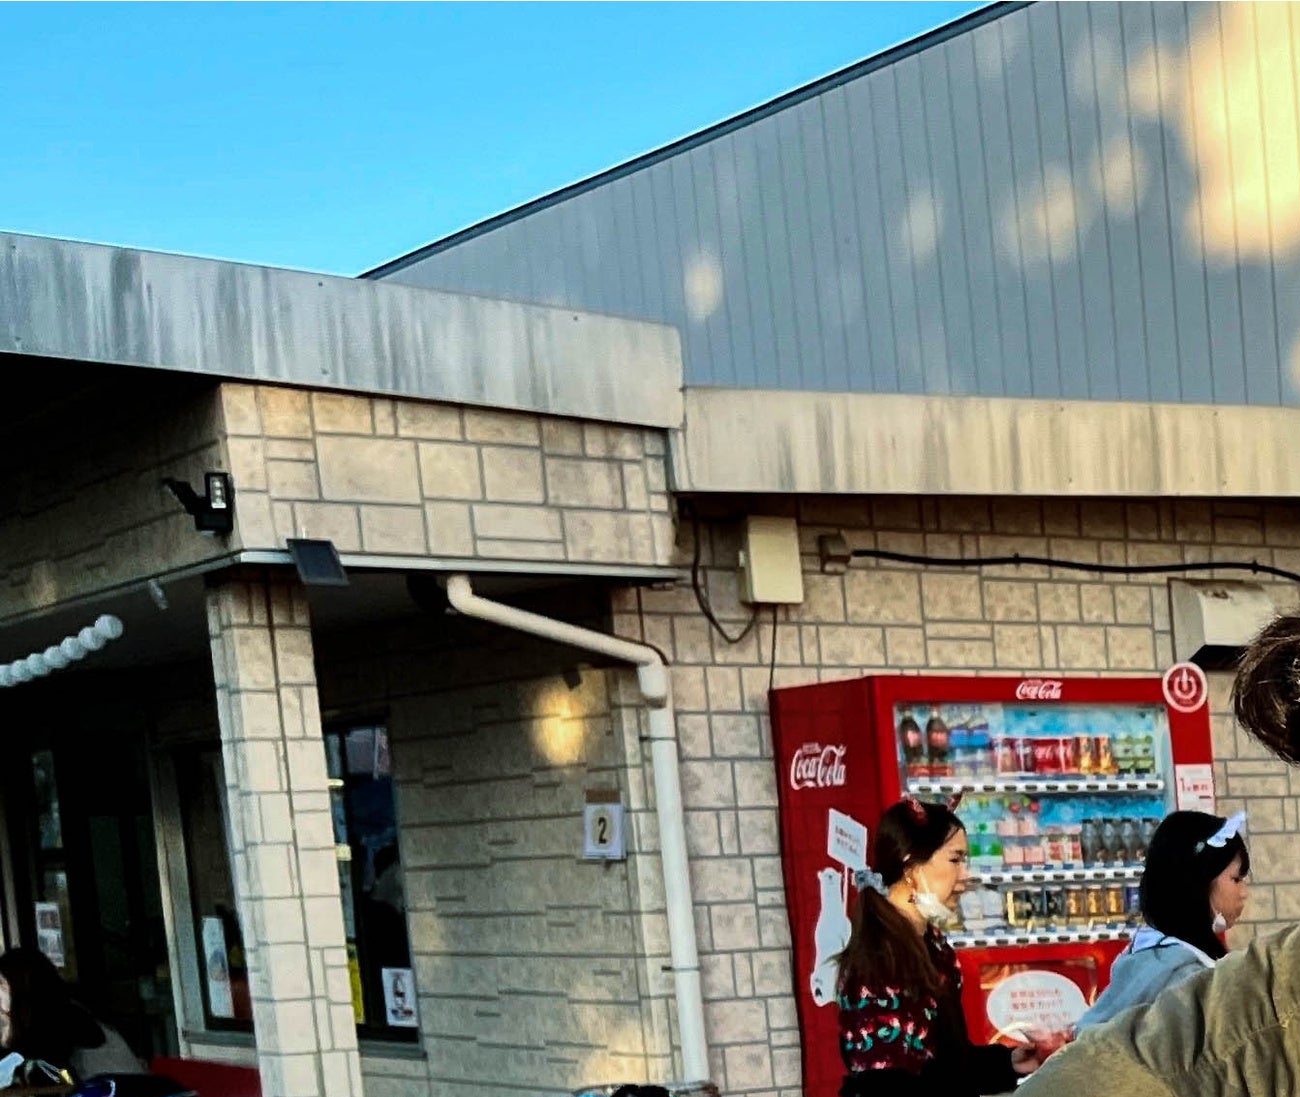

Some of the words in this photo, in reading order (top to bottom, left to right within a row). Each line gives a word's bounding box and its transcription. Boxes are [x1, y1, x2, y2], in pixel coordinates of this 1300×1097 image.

[1015, 679, 1063, 700] Coca-Cola
[790, 744, 847, 790] Coca-Cola
[598, 816, 608, 845] 2
